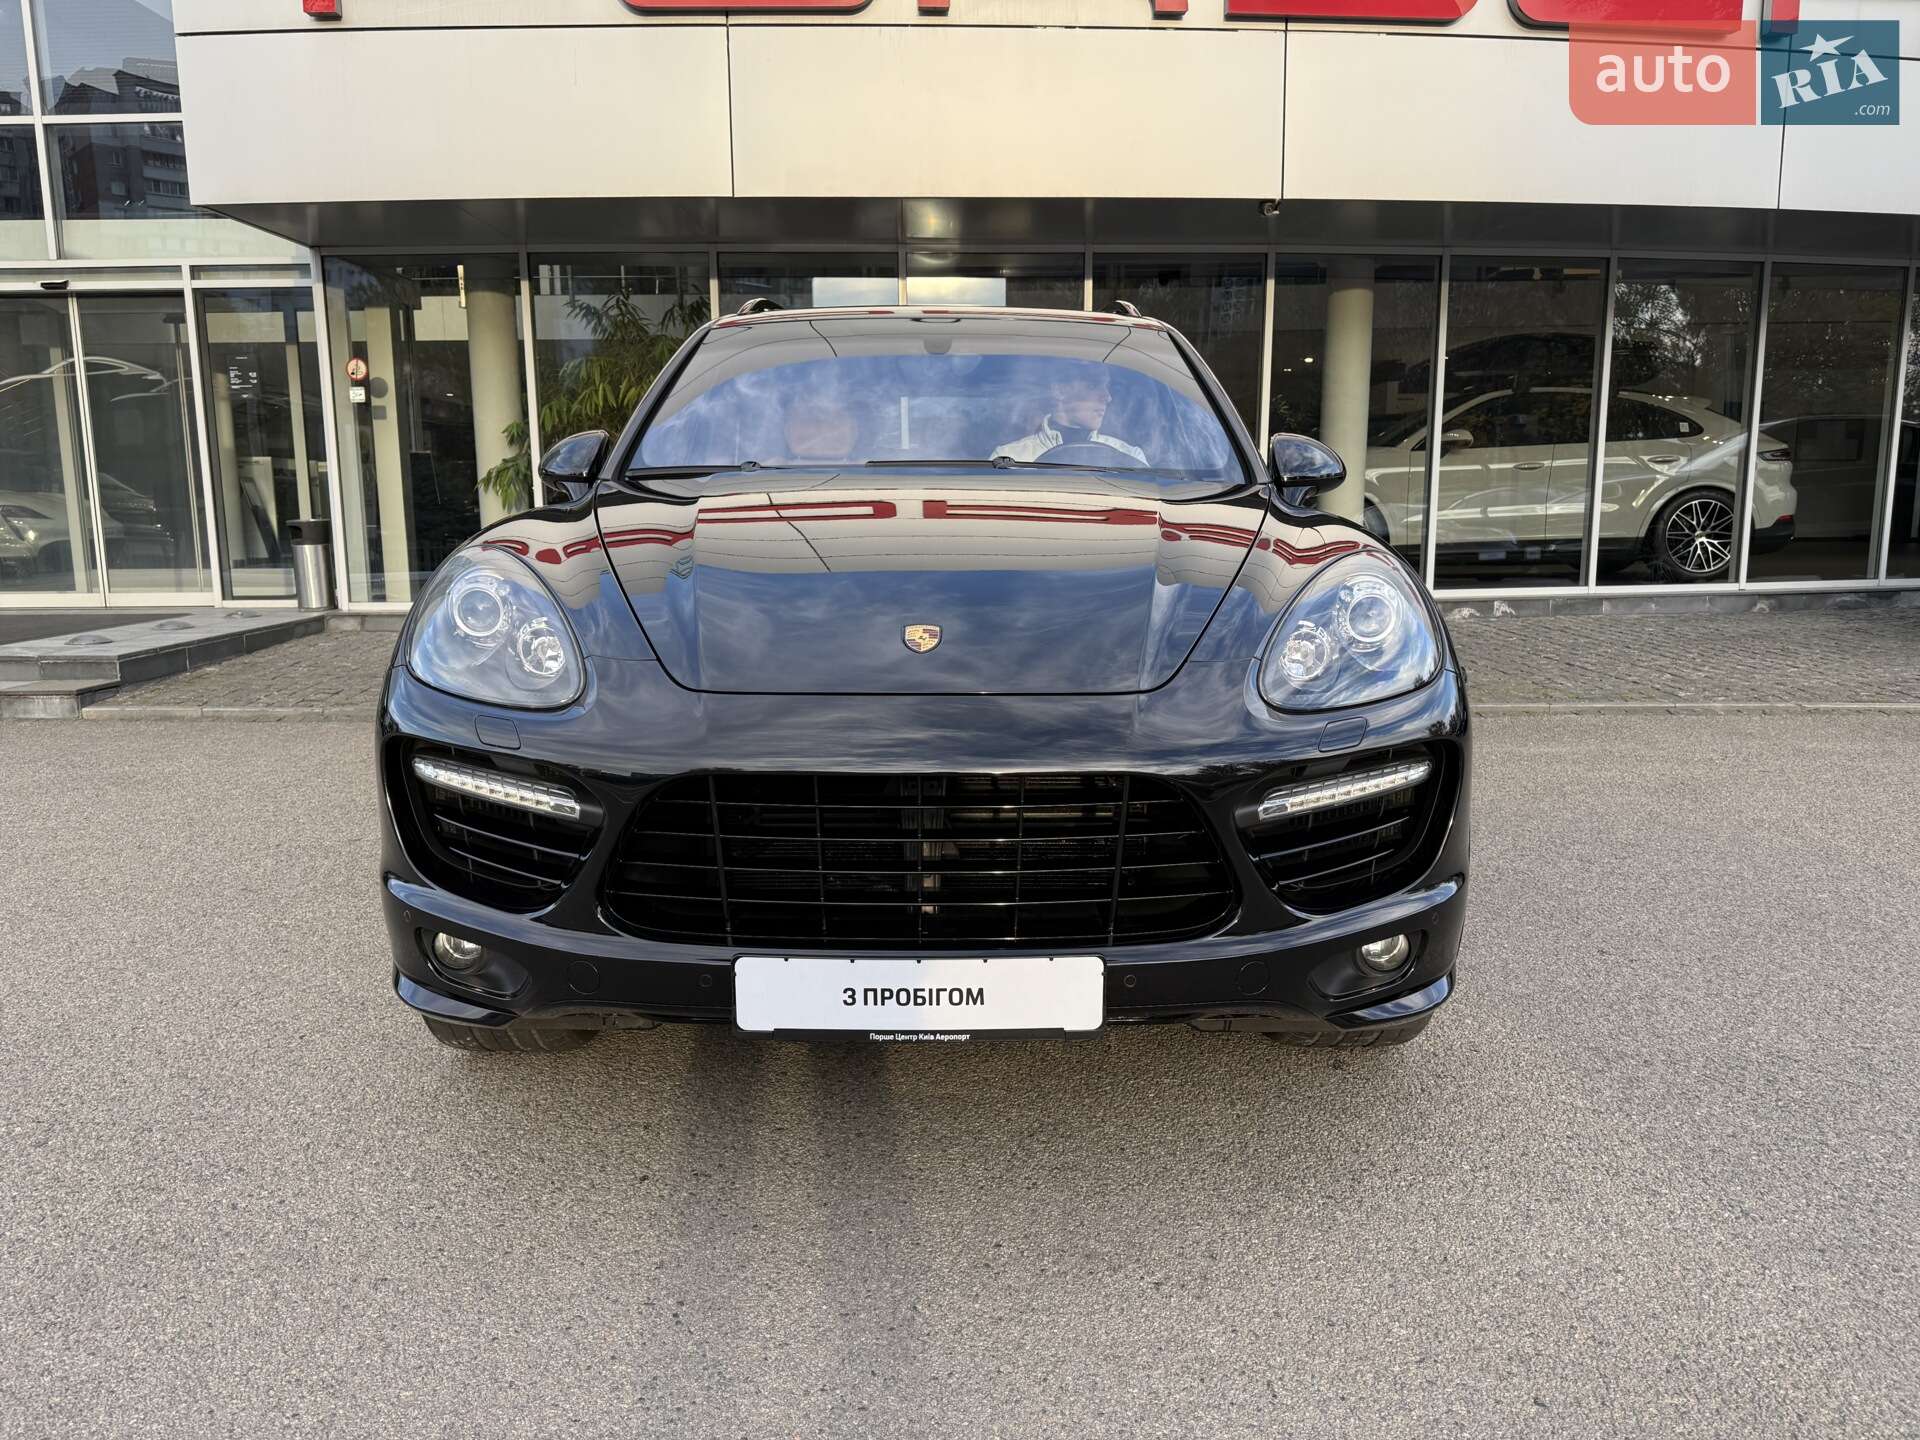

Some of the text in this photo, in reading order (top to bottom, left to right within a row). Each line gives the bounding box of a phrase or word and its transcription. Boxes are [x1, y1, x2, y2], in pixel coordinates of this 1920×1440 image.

[863, 987, 986, 1007] ПРОБІГОМ
[869, 1032, 894, 1042] Порше
[895, 1033, 918, 1042] Центр
[935, 1032, 971, 1042] Аеропорт
